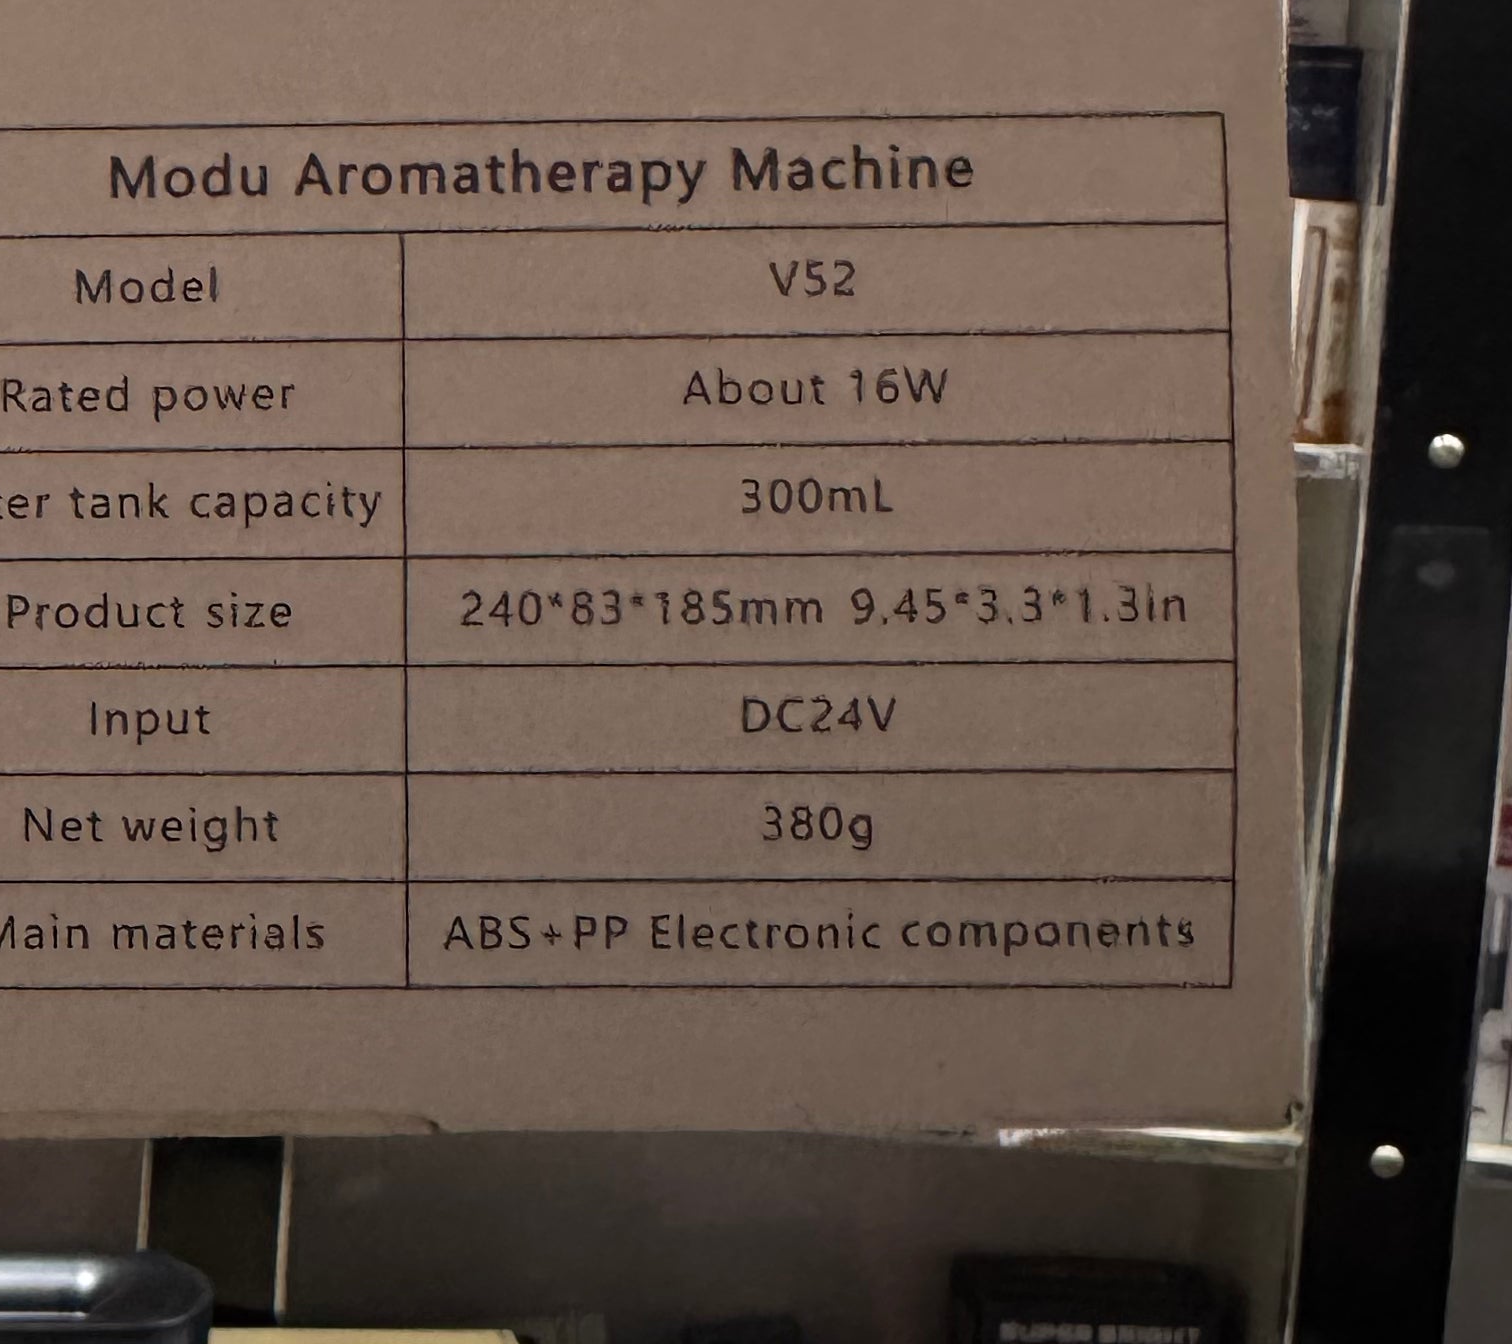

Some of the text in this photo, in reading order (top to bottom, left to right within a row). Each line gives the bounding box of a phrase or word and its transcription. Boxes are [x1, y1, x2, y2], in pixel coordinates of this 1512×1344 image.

[108, 144, 975, 206] Modu Aromatherapy Machine
[73, 265, 220, 306] Model
[768, 259, 856, 298] V52
[1, 374, 296, 423] Rated power
[682, 367, 950, 406] About 16W
[70, 481, 170, 521] tank
[188, 482, 383, 529] capacity
[738, 477, 894, 516] 300mL
[5, 590, 294, 630] Product size
[88, 700, 212, 746] Input
[740, 694, 898, 735] DC24V
[22, 805, 281, 853] Net weight
[760, 804, 876, 852] 380g
[111, 911, 327, 951] materials
[442, 909, 1196, 955] ABS+PP Electronic components
